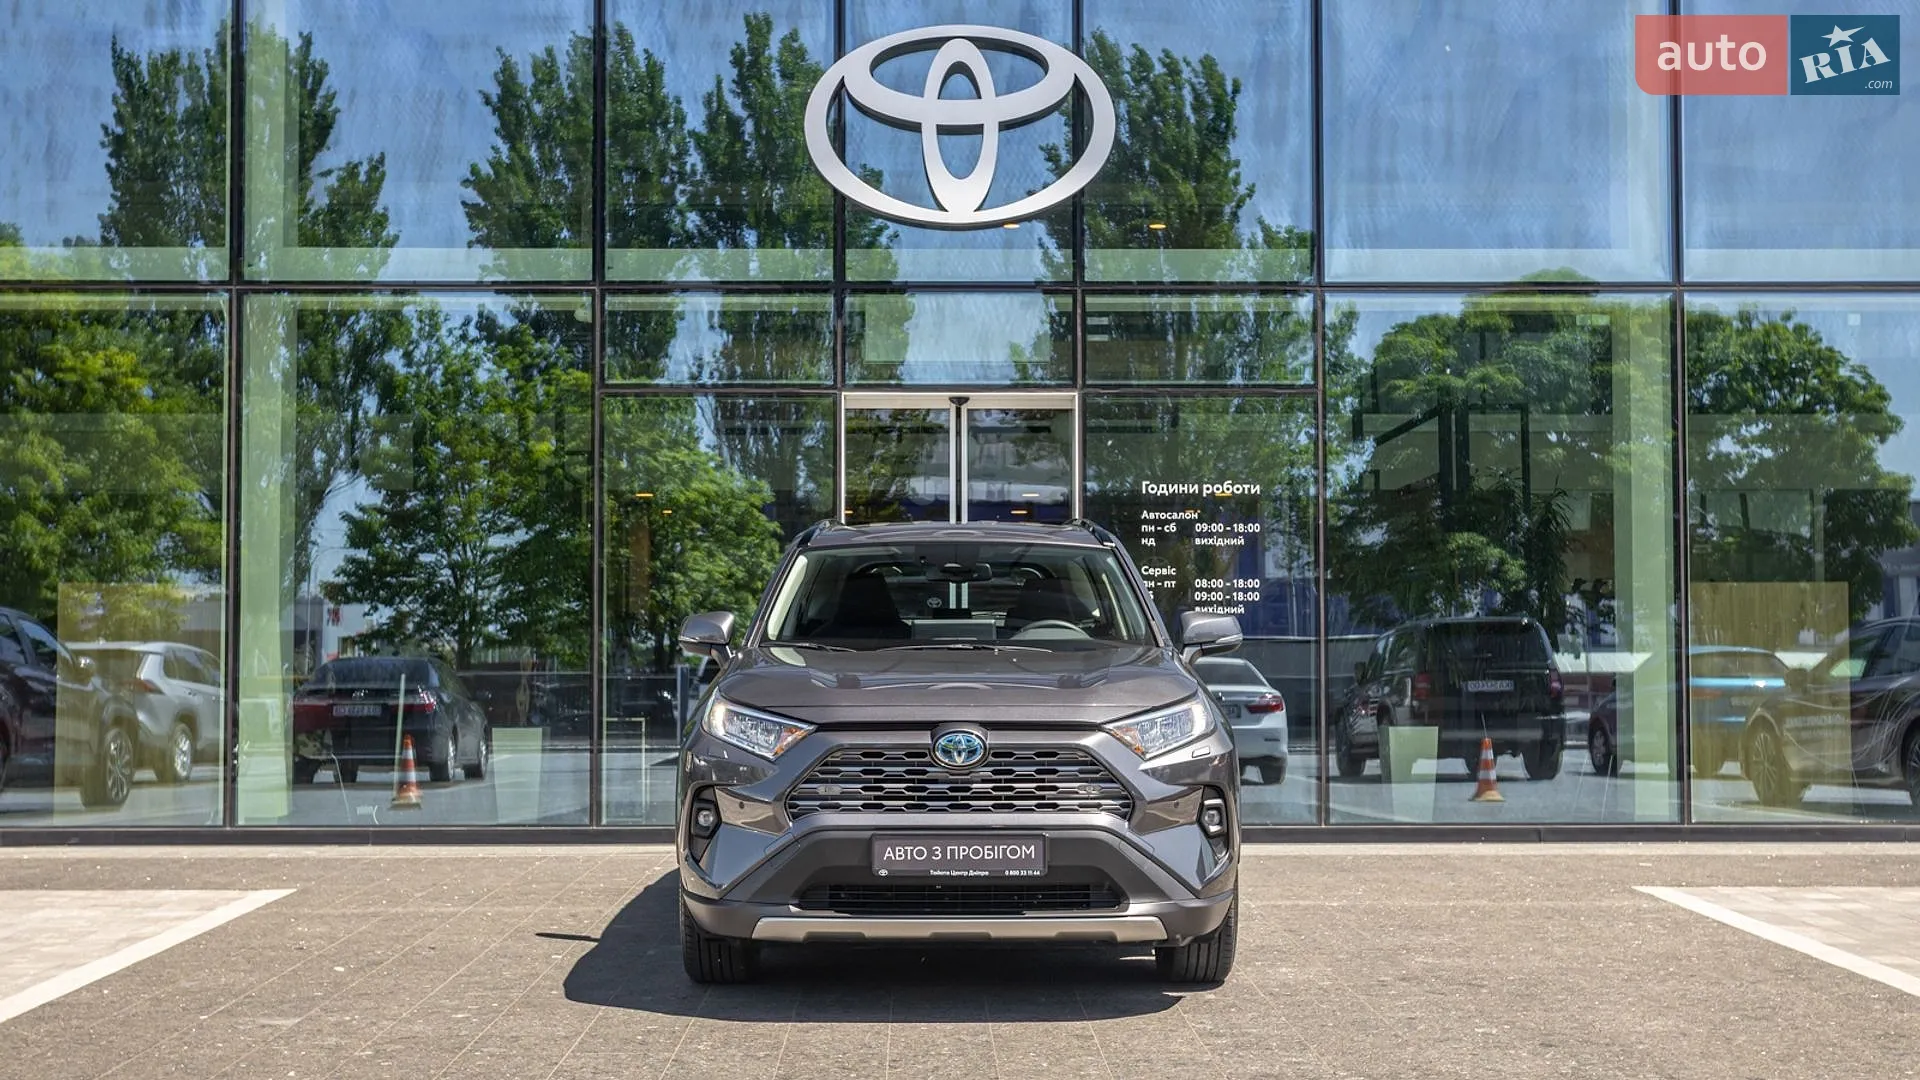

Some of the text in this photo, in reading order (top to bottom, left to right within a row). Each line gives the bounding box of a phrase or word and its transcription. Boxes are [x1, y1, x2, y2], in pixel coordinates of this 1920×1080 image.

[1142, 480, 1260, 497] Години роботи
[1141, 510, 1198, 519] Автосалон
[1142, 524, 1154, 532] пн
[1164, 523, 1177, 532] сб
[1195, 523, 1224, 532] 09:00
[1233, 523, 1260, 532] 18:00
[1141, 536, 1245, 546] нд вихідний
[1141, 565, 1176, 577] Сервіс
[1195, 579, 1224, 588] 08:00
[1233, 579, 1260, 588] 18:00
[1195, 591, 1224, 601] 09:00
[1233, 591, 1260, 601] 18:00
[1195, 604, 1245, 614] вихідний
[883, 845, 1035, 860] АВТО З ПРОБІГОМ
